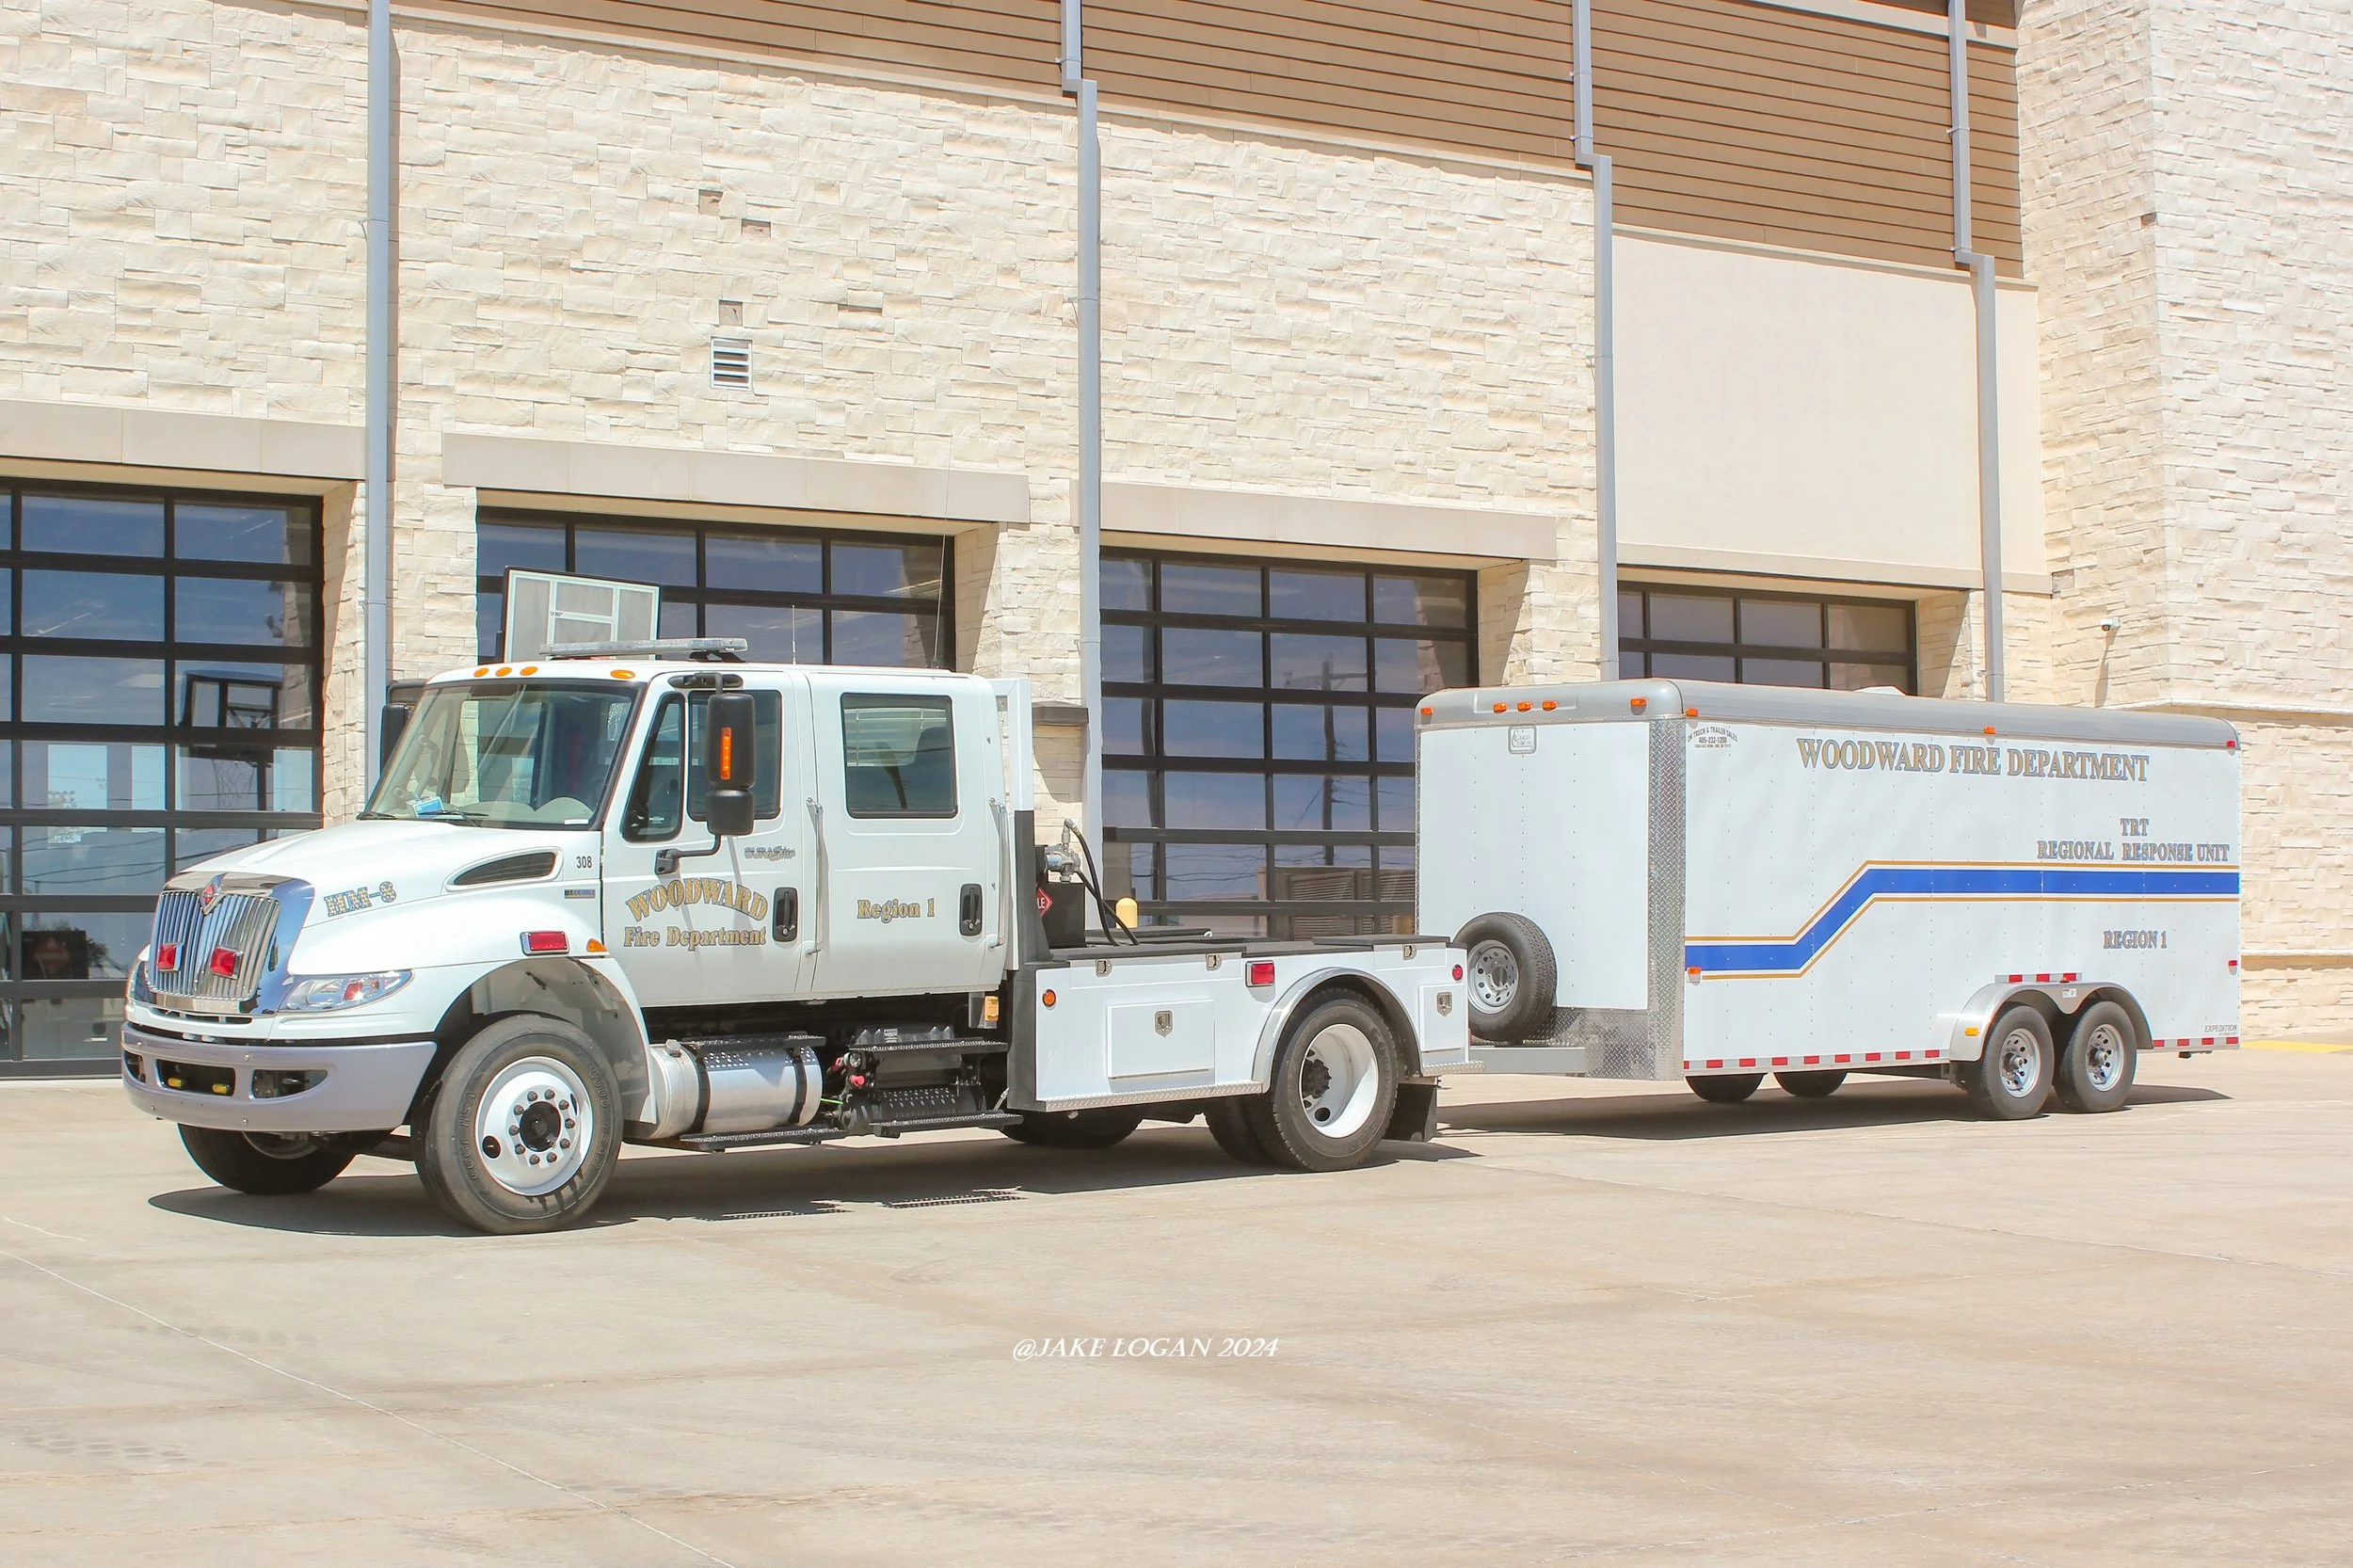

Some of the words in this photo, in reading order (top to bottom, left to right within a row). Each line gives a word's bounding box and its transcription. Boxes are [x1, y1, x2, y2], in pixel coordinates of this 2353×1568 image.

[1693, 728, 1705, 738] TRUCK
[1710, 726, 1726, 735] TRAILER
[1797, 738, 1945, 773] WOODWARD
[1948, 744, 2002, 776] FIRE
[2007, 748, 2150, 781] DEPARTMENT
[2120, 818, 2149, 837] TRT
[2037, 840, 2114, 859] REGIONAL
[2121, 842, 2193, 861] RESPONSE
[2196, 843, 2230, 861] UNIT
[576, 856, 592, 869] 308
[323, 881, 397, 917] HM-8
[626, 877, 769, 922] WOODWARD
[857, 899, 920, 923] Region
[927, 898, 935, 918] 1
[624, 926, 661, 947] Fire
[666, 926, 767, 951] Department
[2104, 930, 2157, 949] REGION
[2160, 931, 2168, 949] 1
